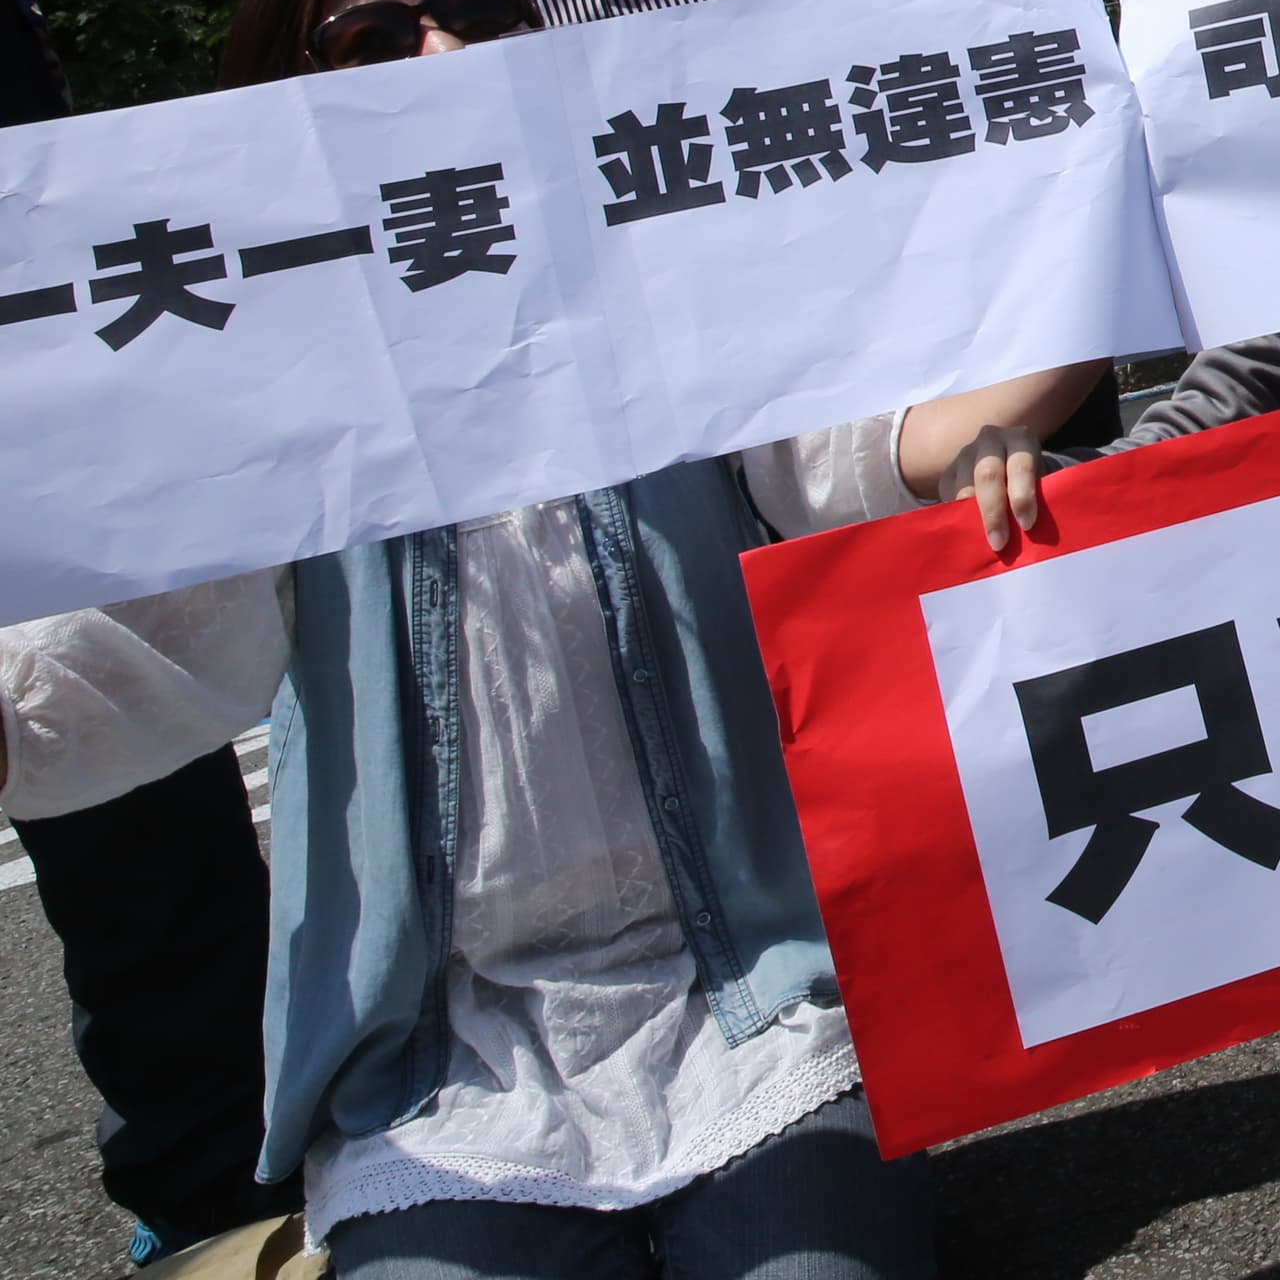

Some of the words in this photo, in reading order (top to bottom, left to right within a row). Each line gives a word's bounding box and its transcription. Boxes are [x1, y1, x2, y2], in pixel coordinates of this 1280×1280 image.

[0, 163, 517, 352] 一夫一妻
[592, 29, 1096, 227] 並無違憲
